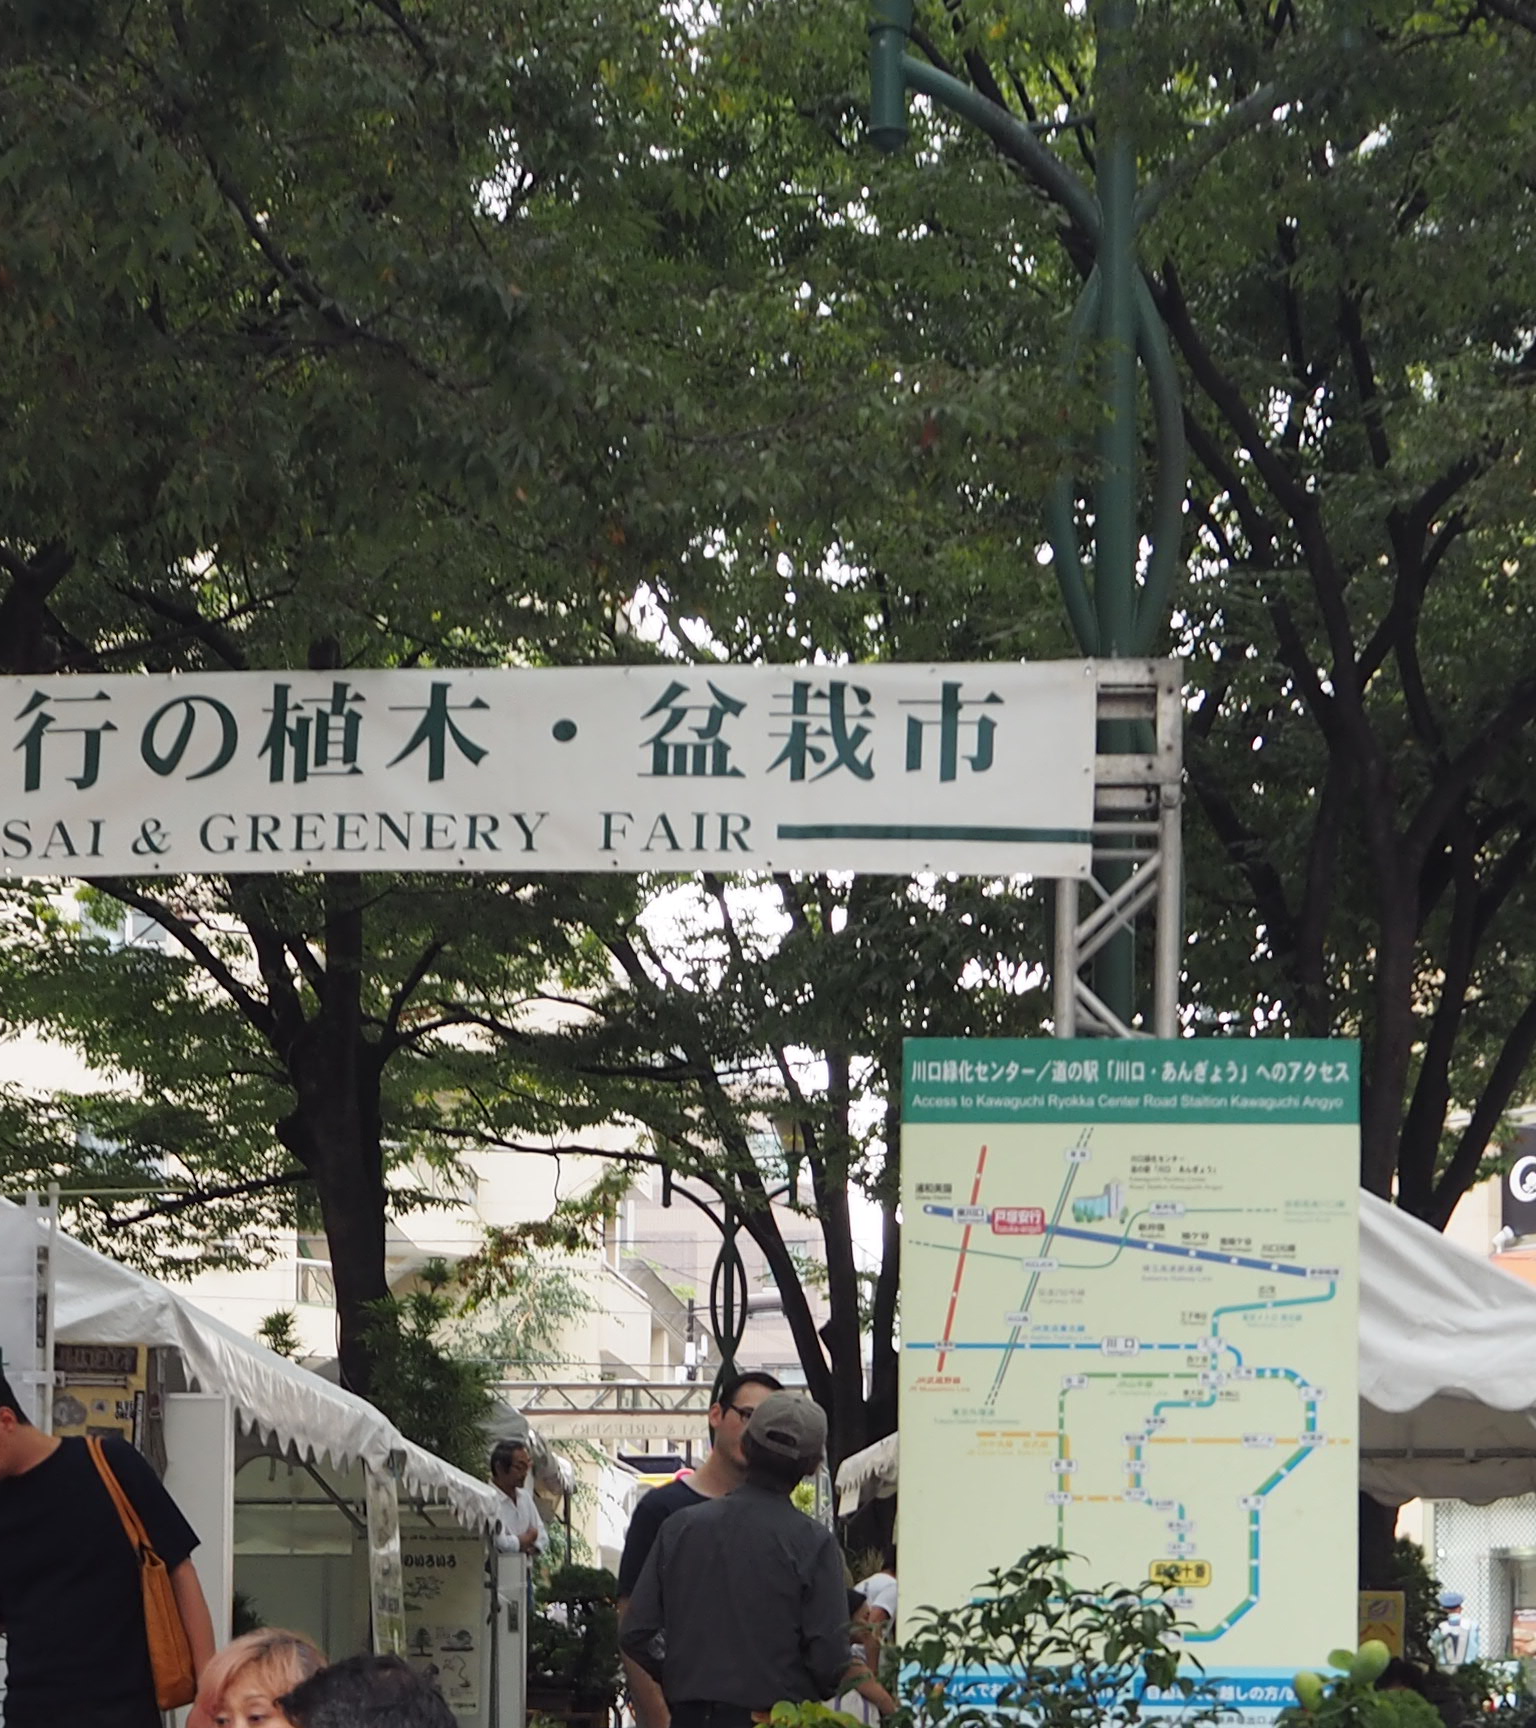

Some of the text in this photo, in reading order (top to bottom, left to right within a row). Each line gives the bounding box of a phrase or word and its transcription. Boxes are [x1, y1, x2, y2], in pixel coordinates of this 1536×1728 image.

[131, 818, 172, 856] &
[200, 812, 549, 855] GREENERY
[602, 812, 754, 853] FAIR
[912, 1094, 958, 1108] Access
[961, 1095, 972, 1107] to
[976, 1094, 1045, 1110] Kawaguchi
[1048, 1094, 1094, 1110] Ryokka
[1098, 1094, 1139, 1108] Center
[1143, 1094, 1177, 1108] Road
[1230, 1094, 1300, 1111] Kawaguchi
[1302, 1095, 1344, 1111] Angyo
